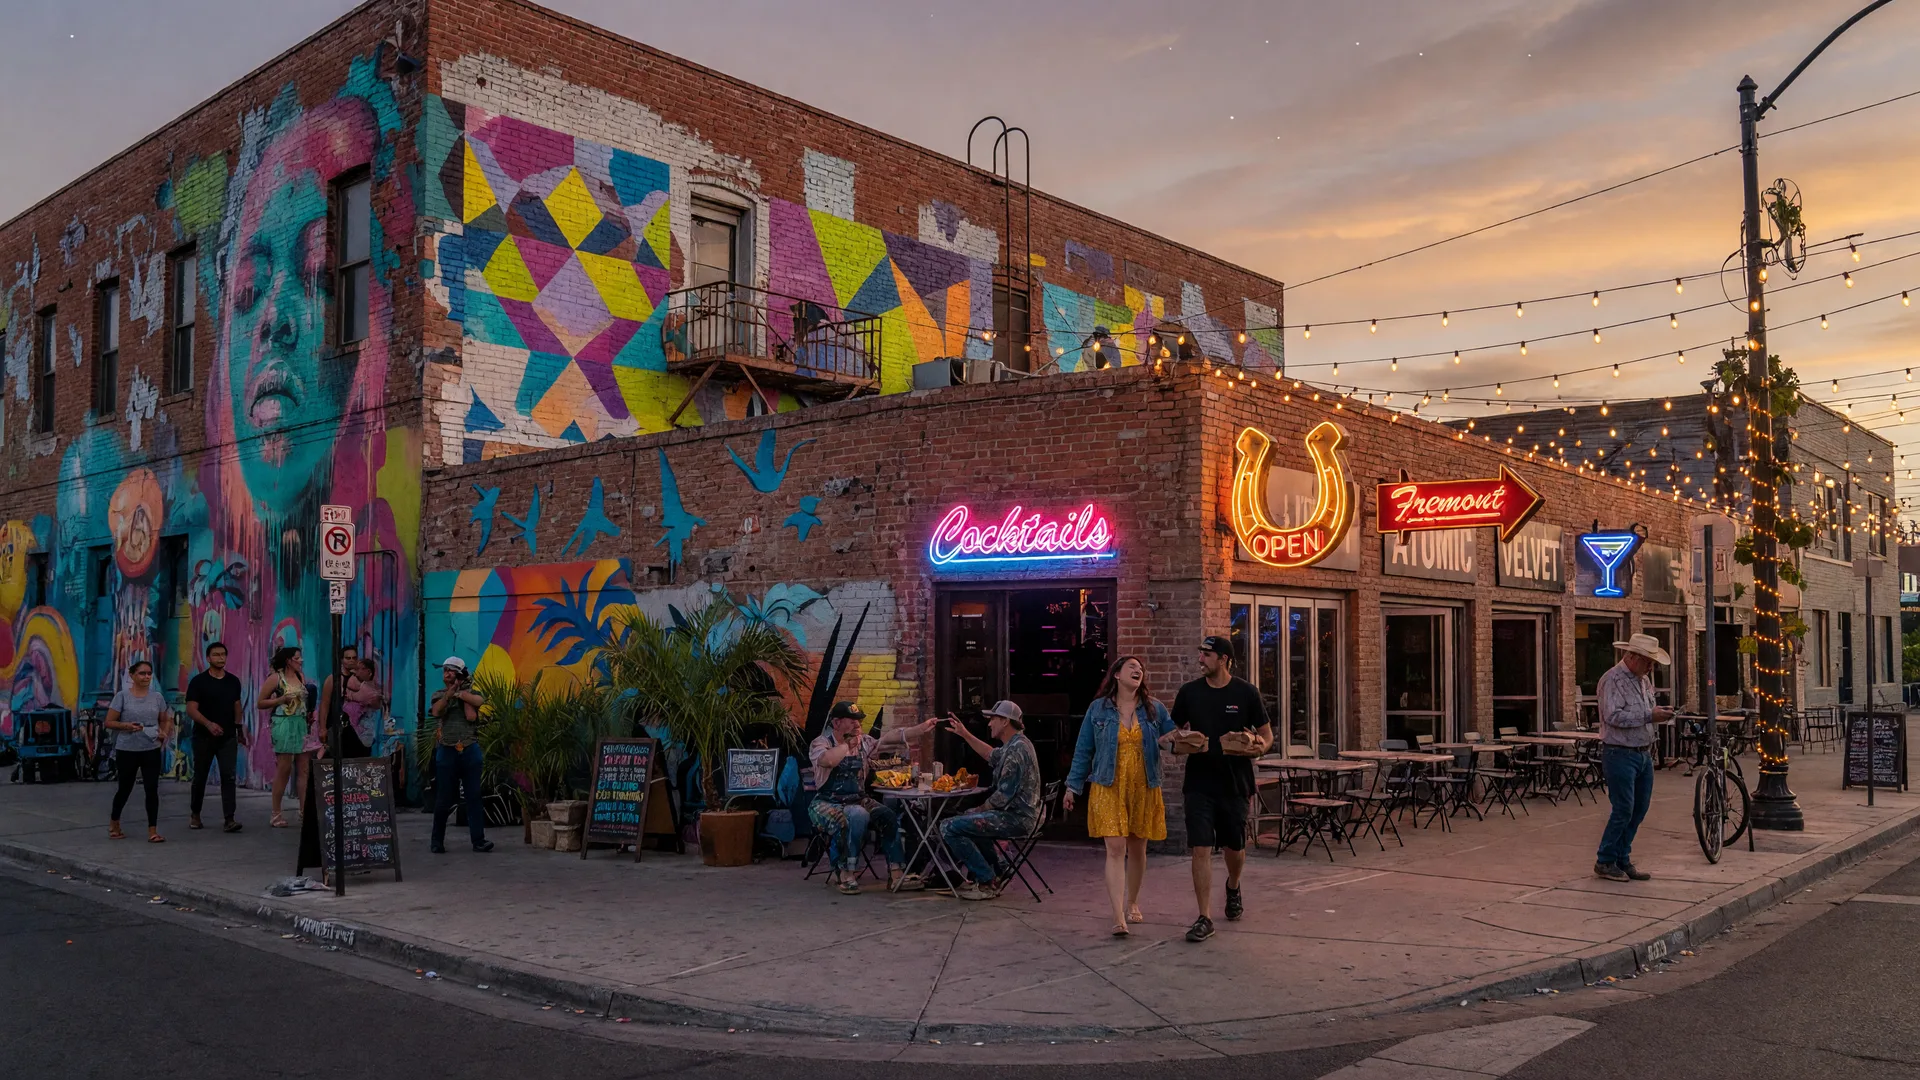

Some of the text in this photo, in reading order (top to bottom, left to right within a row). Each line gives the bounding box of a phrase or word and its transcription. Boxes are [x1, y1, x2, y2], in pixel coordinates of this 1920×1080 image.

[1391, 484, 1505, 522] Fremont
[929, 503, 1112, 565] Cocktails
[1252, 528, 1320, 558] OPEN
[1502, 535, 1560, 582] VELVET
